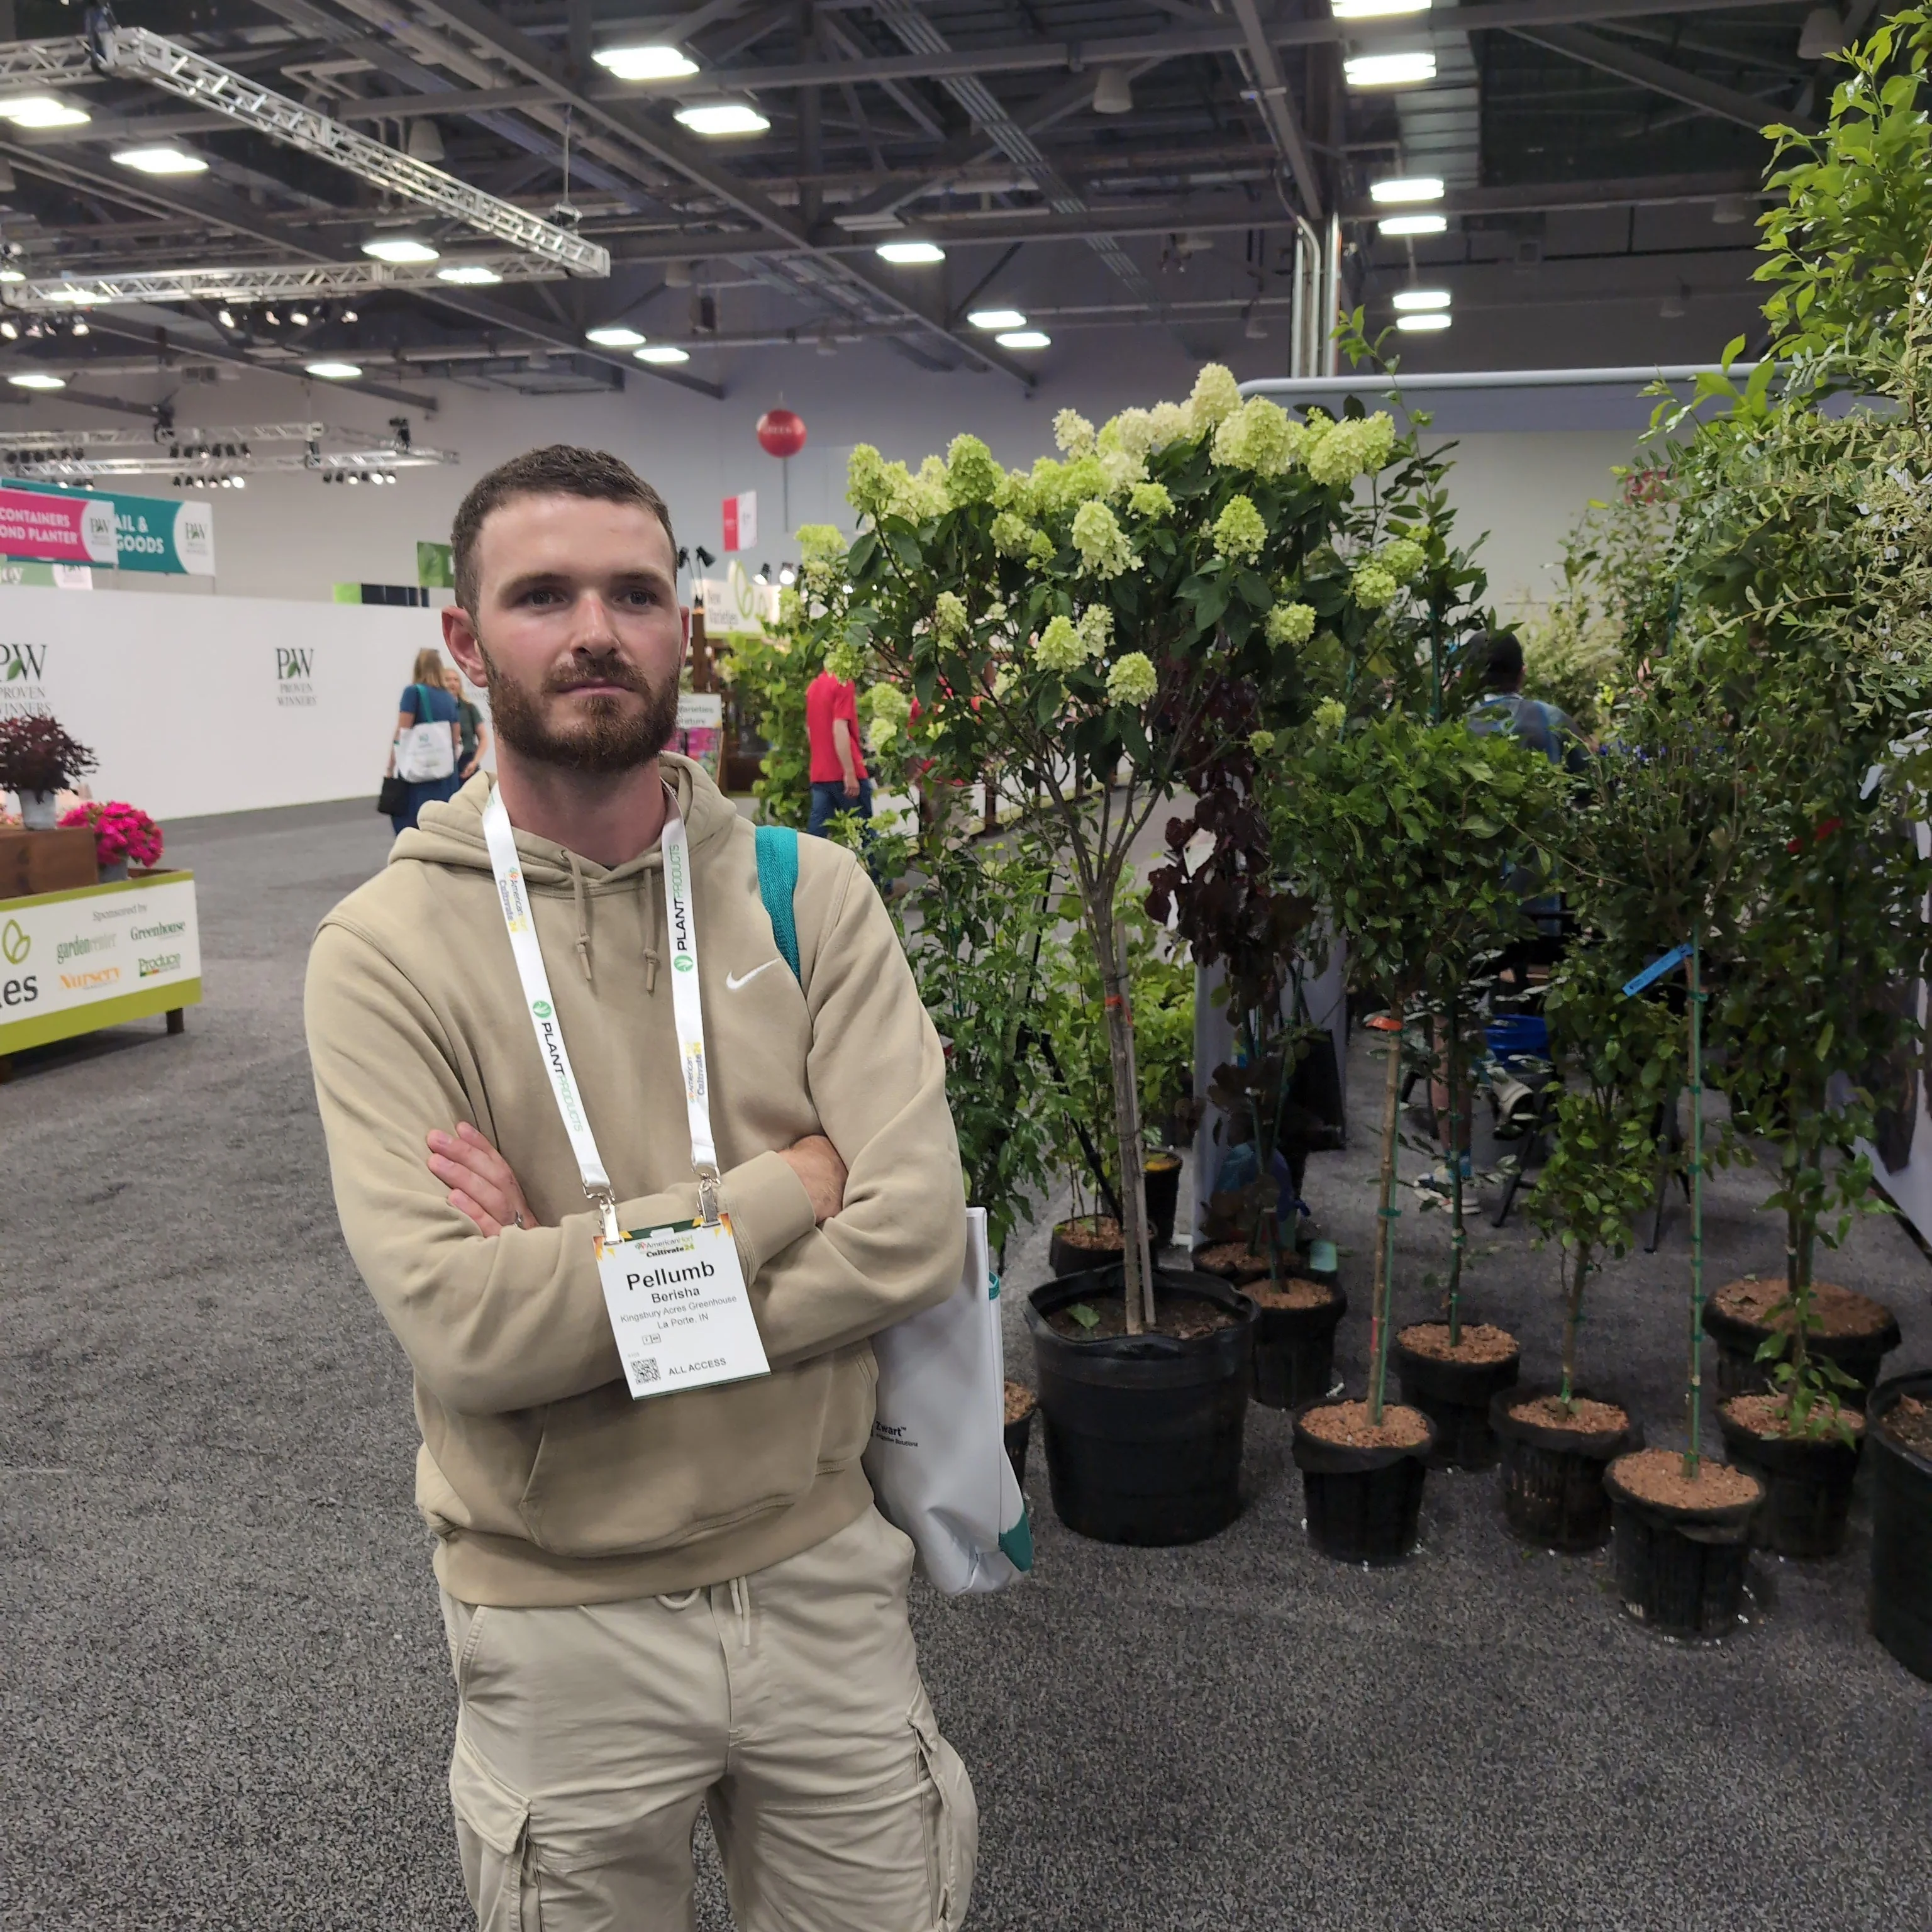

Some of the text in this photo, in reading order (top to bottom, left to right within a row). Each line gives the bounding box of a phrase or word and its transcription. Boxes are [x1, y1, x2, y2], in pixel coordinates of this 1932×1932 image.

[138, 516, 148, 533] &
[28, 526, 78, 545] PLANTER
[117, 535, 165, 555] GOODS
[275, 648, 314, 679] PW
[0, 975, 38, 1008] es
[626, 1261, 715, 1291] Pellumb
[651, 1287, 700, 1303] Berisha
[620, 1295, 737, 1323] Kingsbury Acres Greenhouse
[657, 1321, 669, 1330] La
[699, 1313, 709, 1321] IN
[669, 1357, 727, 1376] ALL ACCESS
